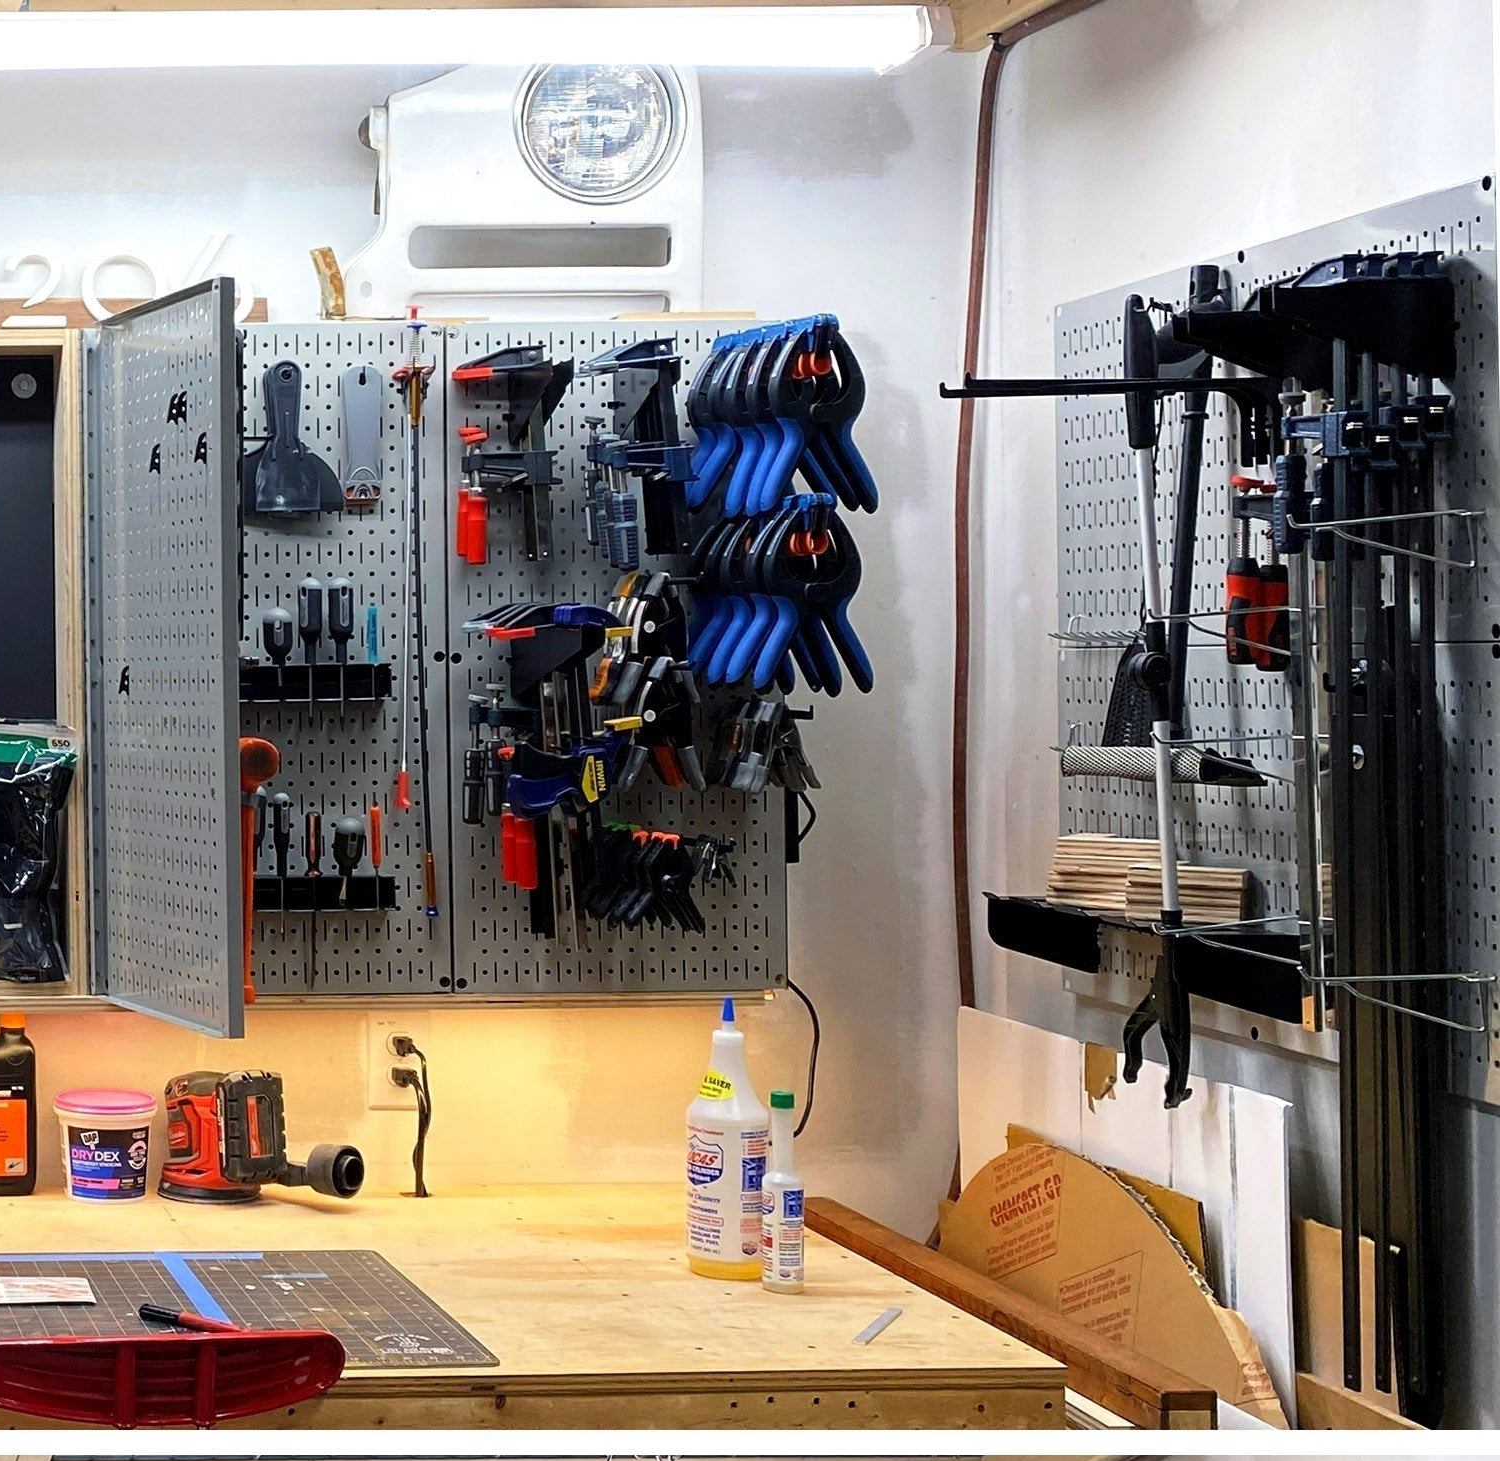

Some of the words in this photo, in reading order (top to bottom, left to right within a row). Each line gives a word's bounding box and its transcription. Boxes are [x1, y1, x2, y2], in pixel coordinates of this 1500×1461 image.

[52, 739, 71, 747] 650
[596, 760, 606, 791] IRWIN
[71, 1148, 120, 1162] DRYDEX
[688, 1151, 718, 1166] UCAS
